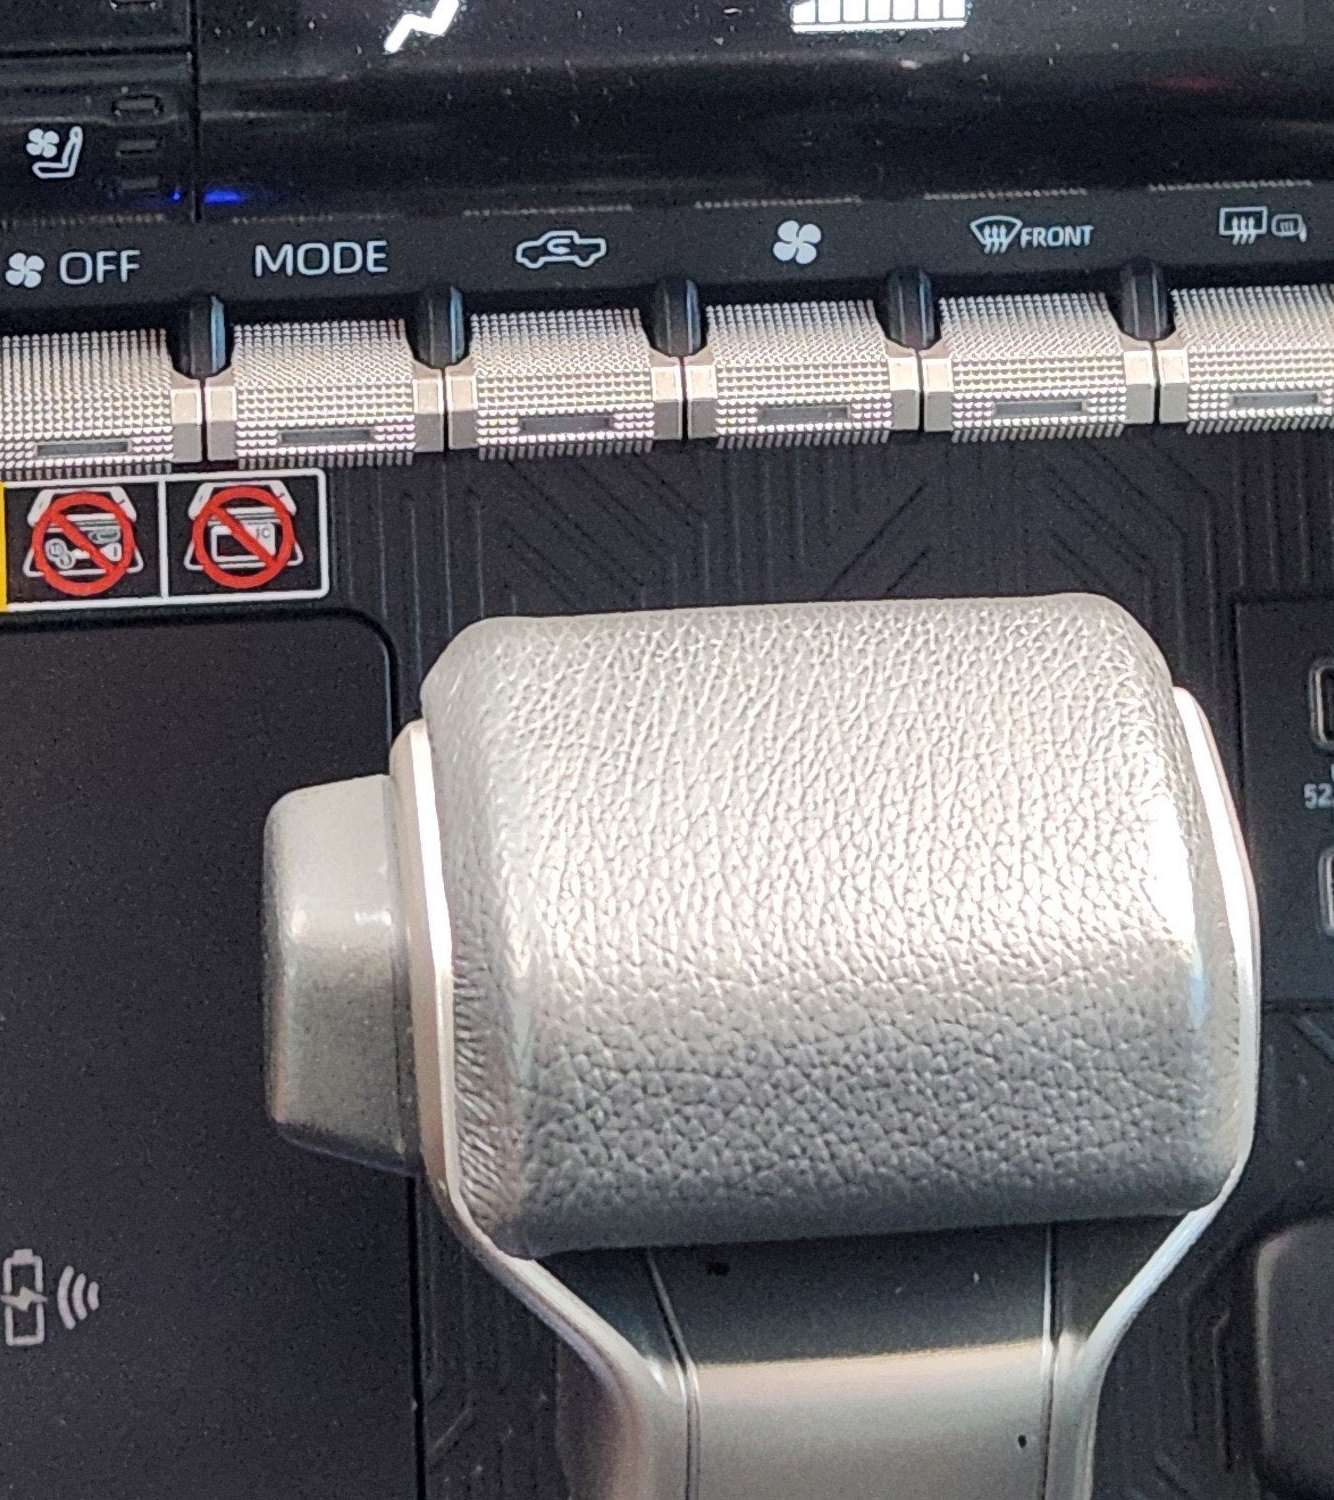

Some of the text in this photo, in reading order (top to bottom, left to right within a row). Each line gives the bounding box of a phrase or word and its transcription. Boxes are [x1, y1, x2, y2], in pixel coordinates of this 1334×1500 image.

[1020, 224, 1095, 249] FRONT
[59, 249, 141, 285] OFF
[255, 240, 389, 277] MODE
